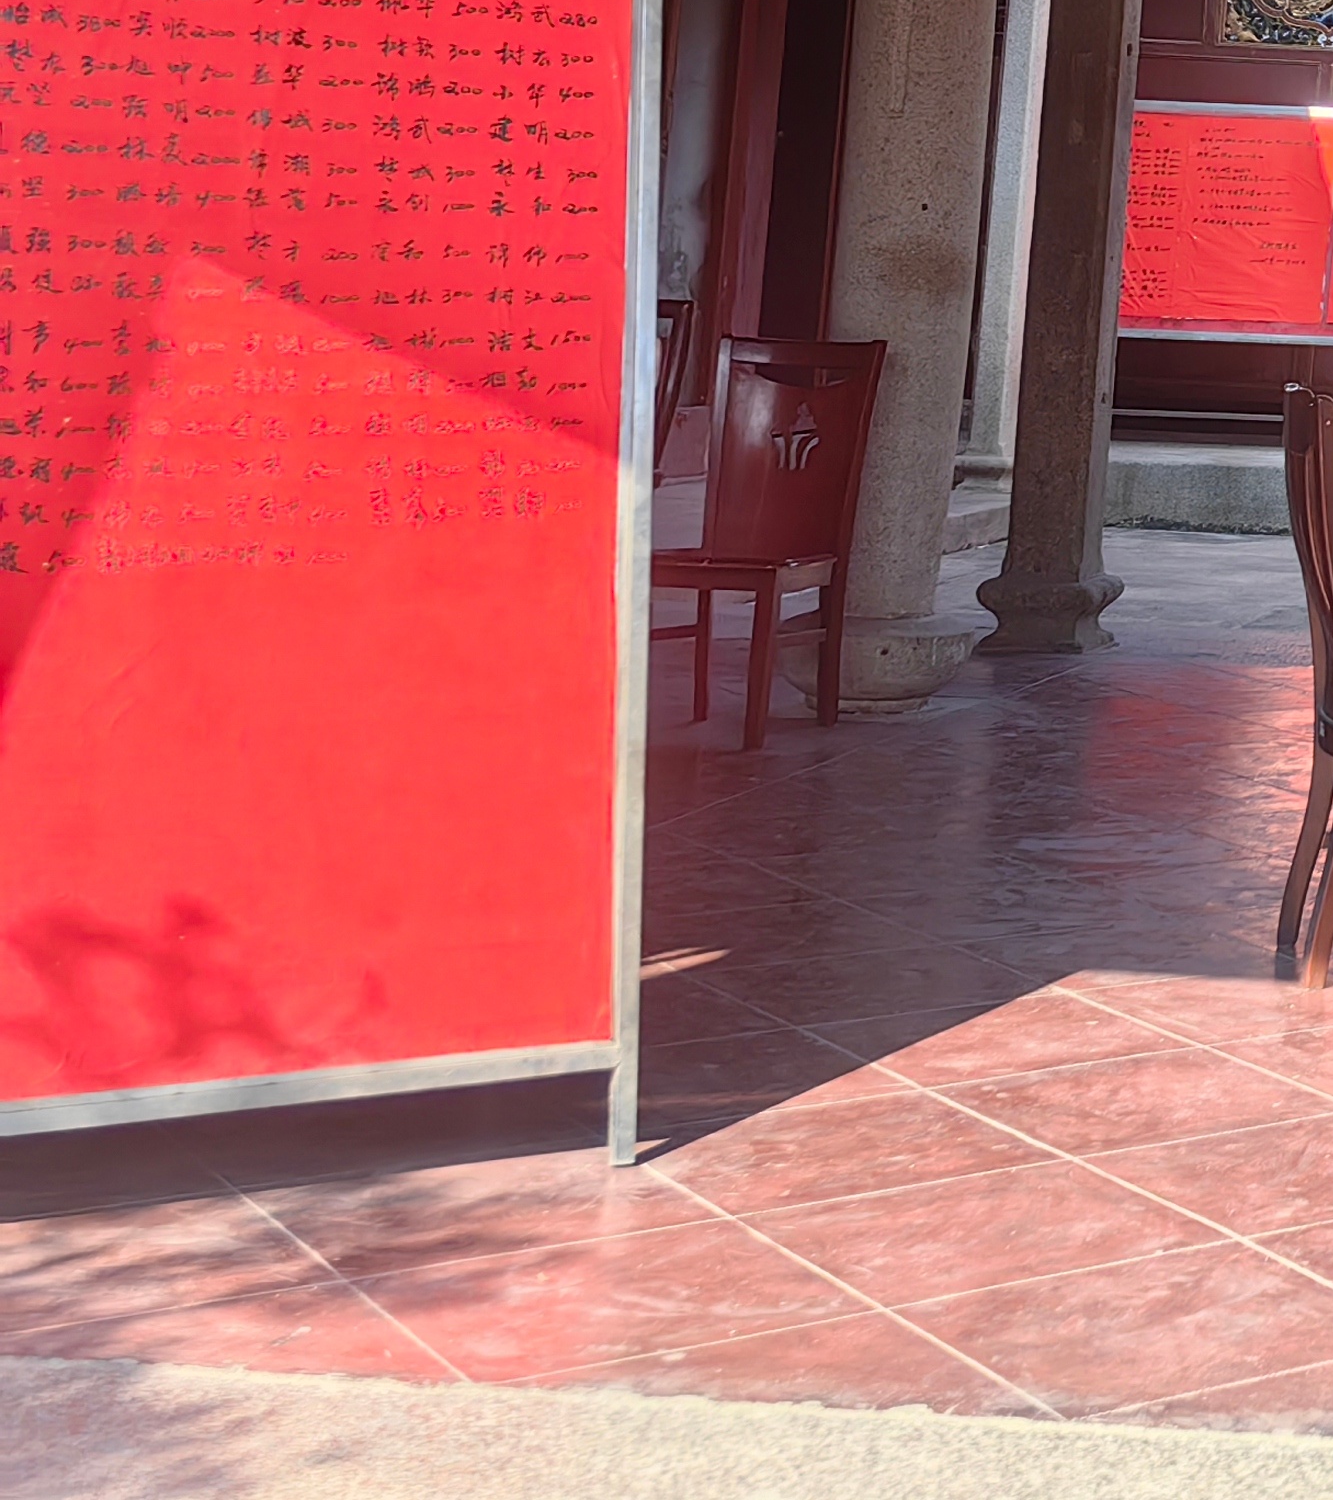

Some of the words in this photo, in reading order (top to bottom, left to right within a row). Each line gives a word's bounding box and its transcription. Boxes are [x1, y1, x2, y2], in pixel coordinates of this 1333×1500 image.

[452, 2, 490, 17] 500
[323, 35, 358, 51] 300
[561, 54, 594, 68] 300
